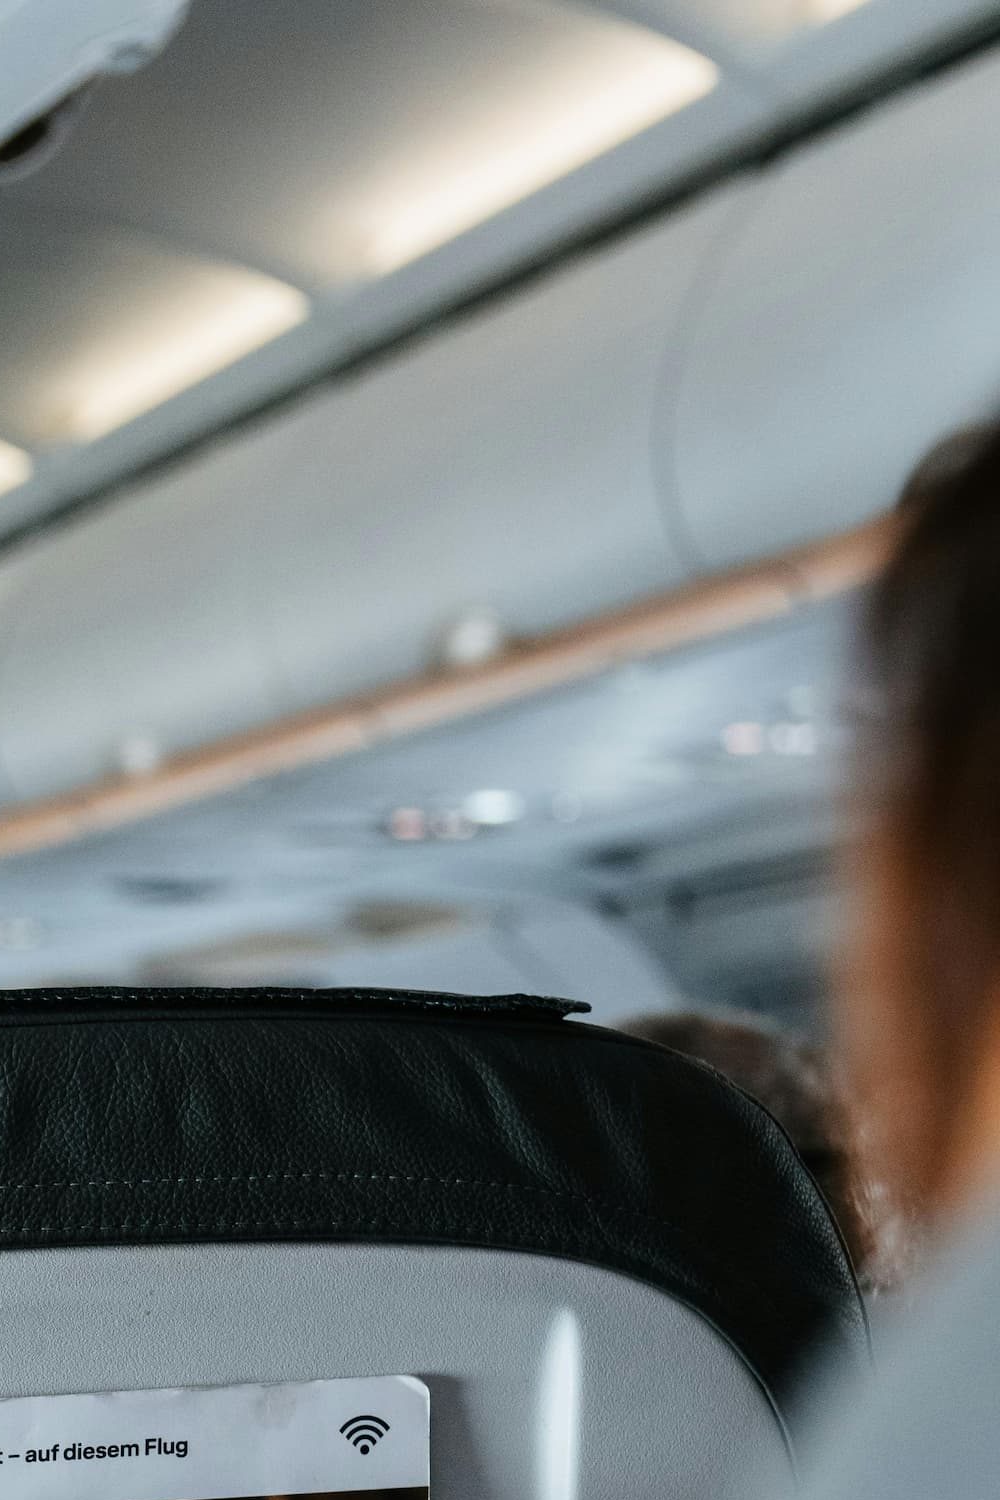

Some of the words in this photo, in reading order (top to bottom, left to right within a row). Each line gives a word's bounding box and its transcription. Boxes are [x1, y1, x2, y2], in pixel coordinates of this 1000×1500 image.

[25, 1444, 60, 1463] auf
[63, 1442, 140, 1460] diesem
[145, 1438, 188, 1457] Flug
